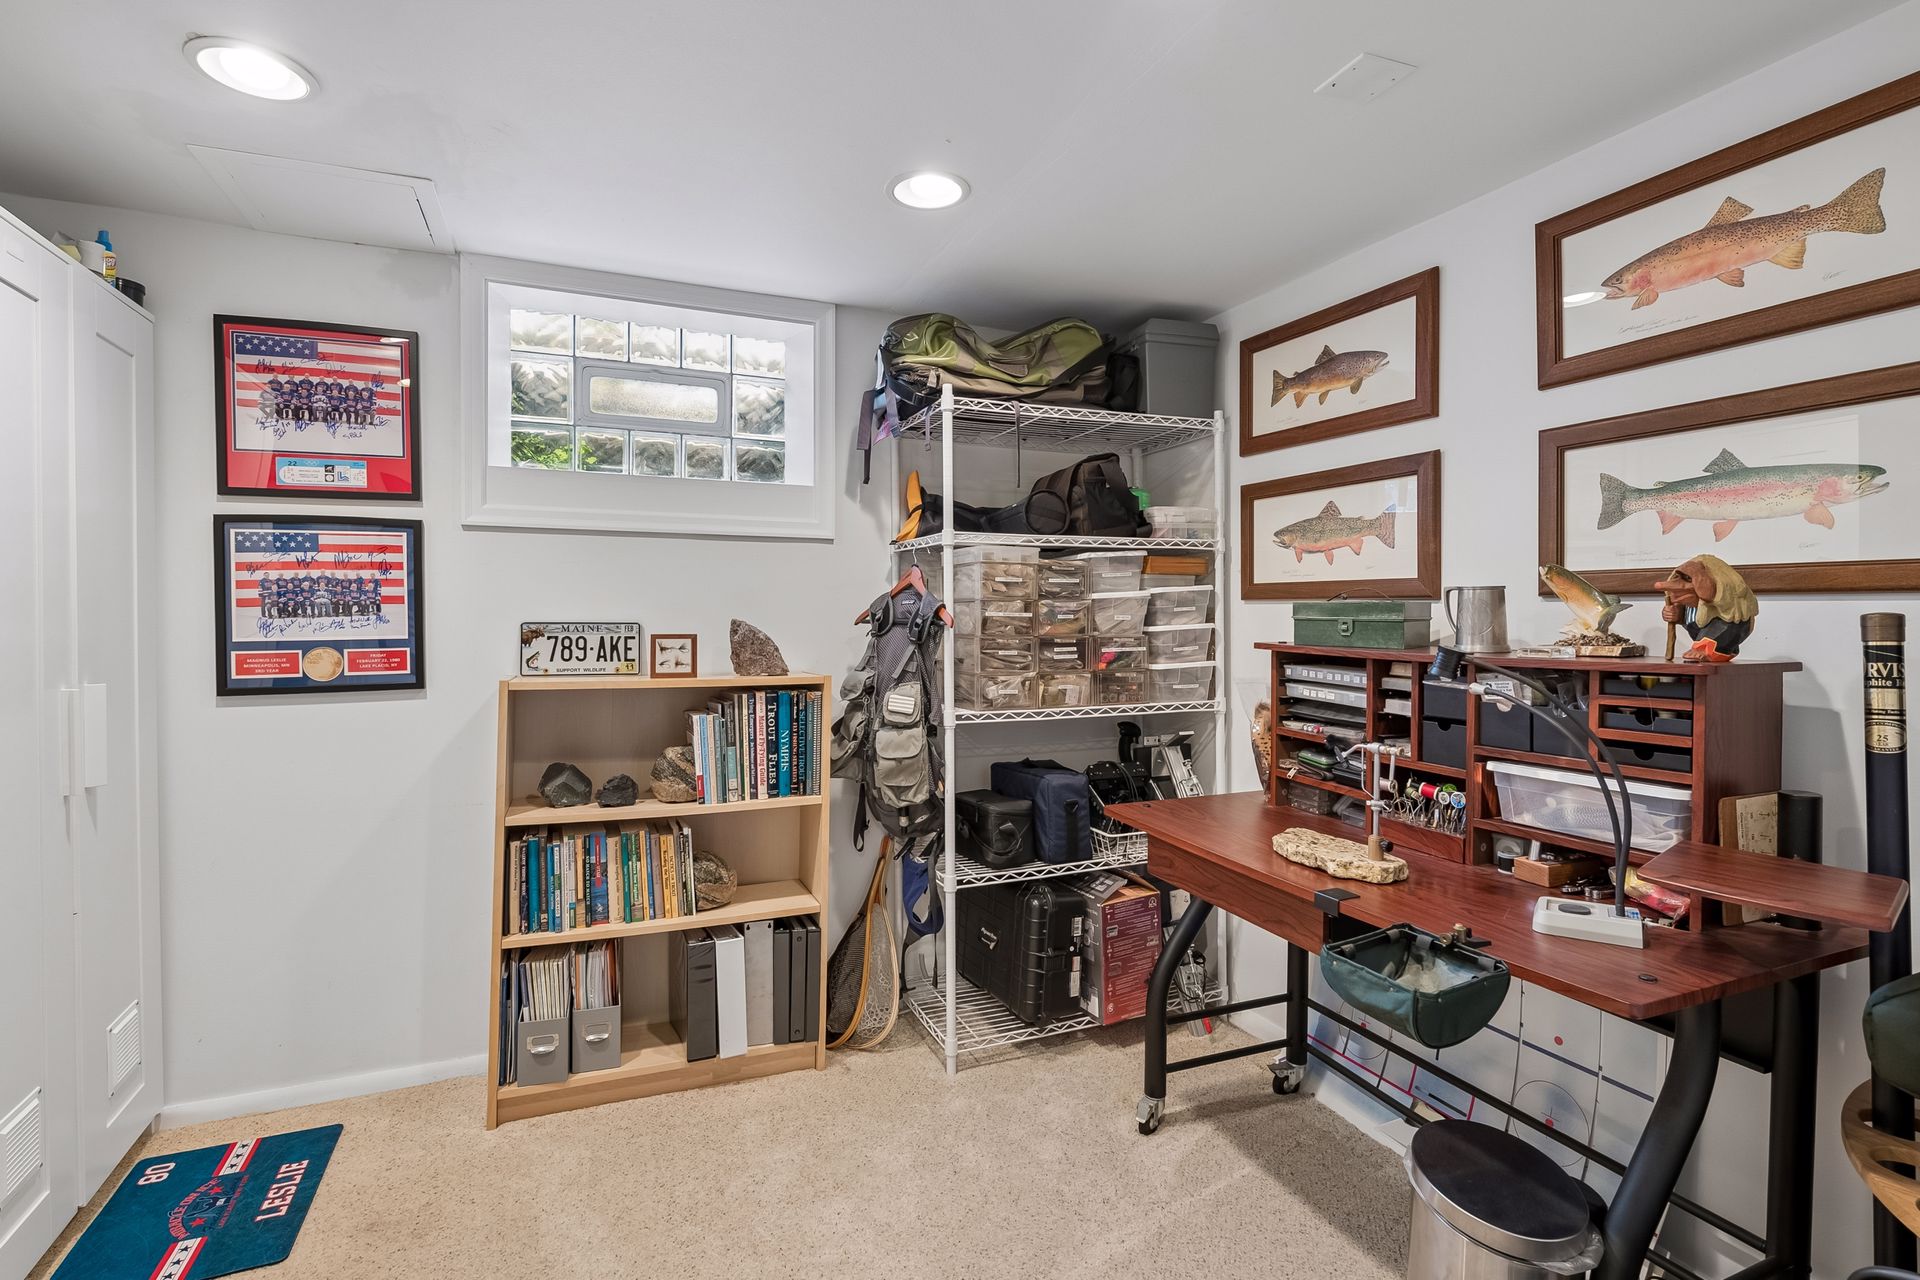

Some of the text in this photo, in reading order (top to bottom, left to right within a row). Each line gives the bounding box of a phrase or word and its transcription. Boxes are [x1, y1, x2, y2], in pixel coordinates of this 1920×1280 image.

[767, 702, 778, 784] TROUT FLIES
[780, 730, 789, 772] NYMPHS
[1876, 734, 1889, 742] 25
[137, 1162, 176, 1186] 80
[255, 1160, 310, 1223] LESLIE
[168, 1206, 190, 1240] MIRACLE
